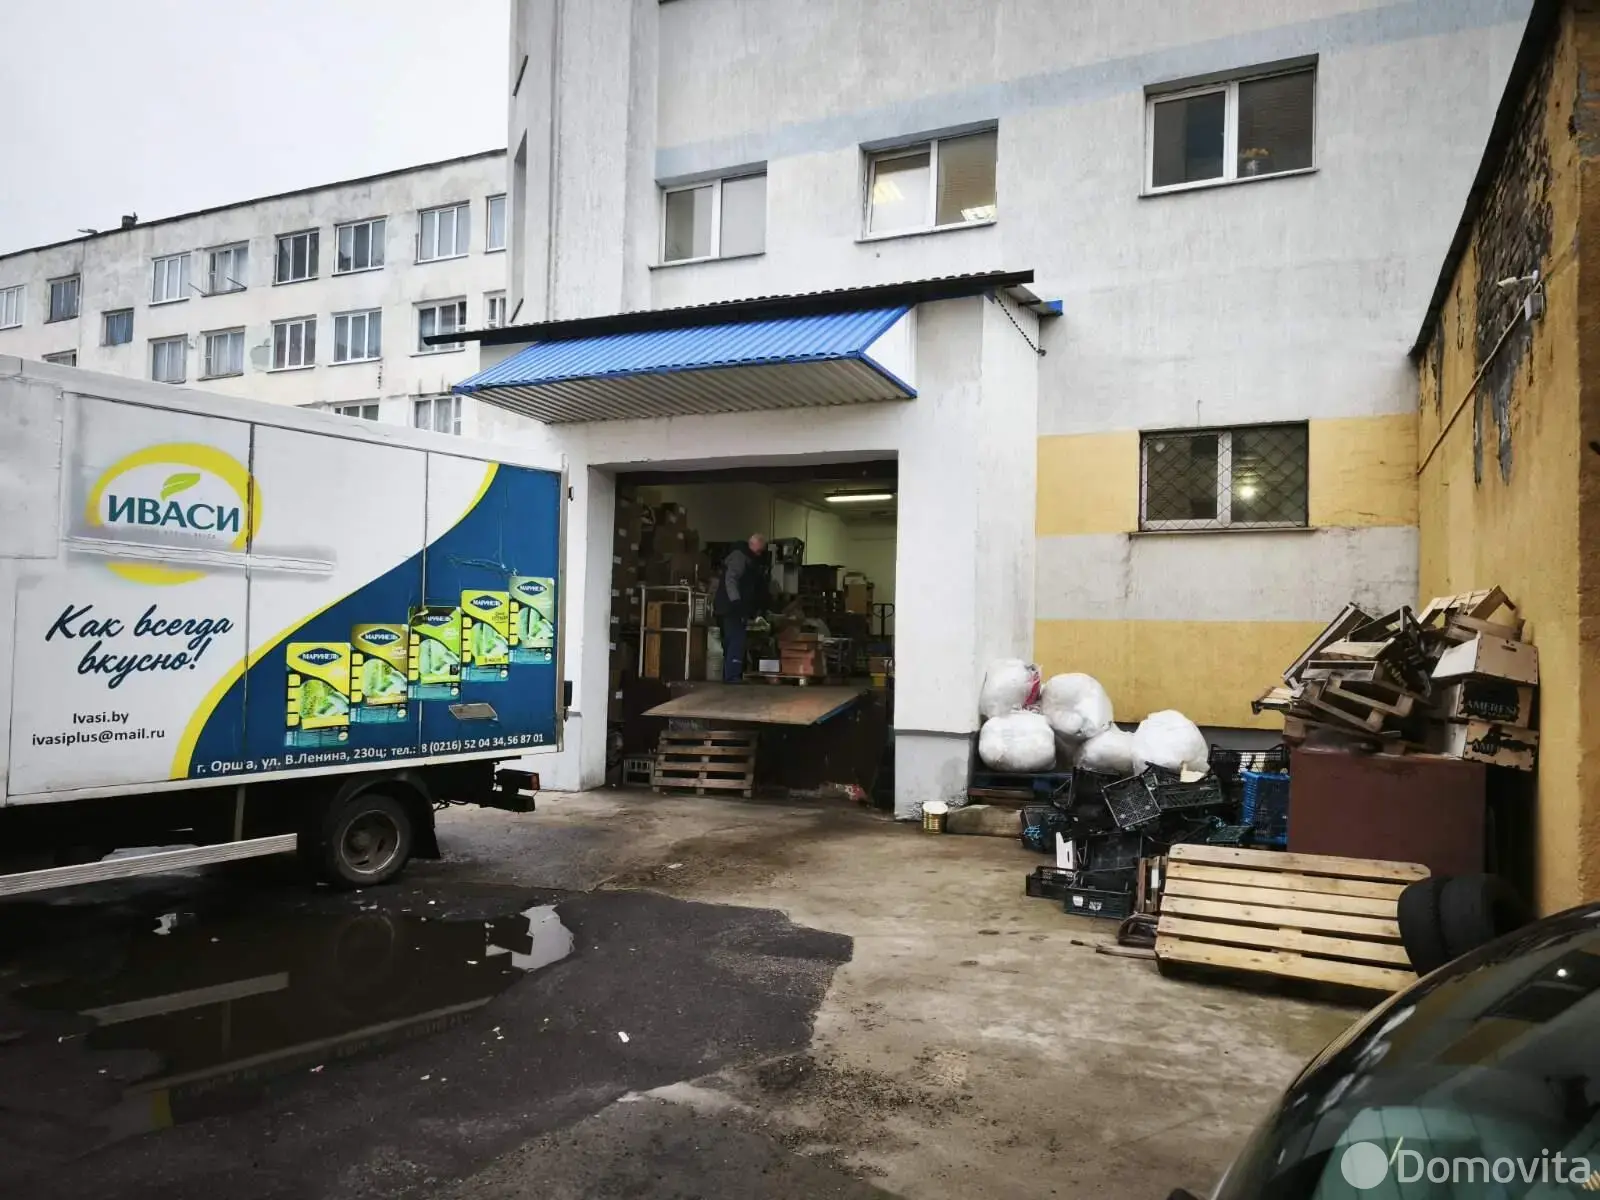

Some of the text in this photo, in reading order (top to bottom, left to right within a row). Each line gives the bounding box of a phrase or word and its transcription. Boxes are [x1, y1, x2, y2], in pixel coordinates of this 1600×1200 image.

[108, 494, 239, 533] ИВАСИ
[45, 604, 235, 651] Как всегда
[77, 637, 213, 690] вкусно!
[32, 728, 165, 747] ivasiplus@mail.ru
[72, 711, 130, 725] Ivasi.by
[196, 764, 206, 774] г.
[261, 758, 281, 770] ул.
[285, 751, 350, 765] В.Ленина,
[421, 743, 428, 753] 8
[430, 739, 462, 755] (0216)
[464, 739, 476, 749] 52
[478, 738, 490, 748] 04
[520, 734, 532, 744] 87
[533, 733, 544, 743] 01
